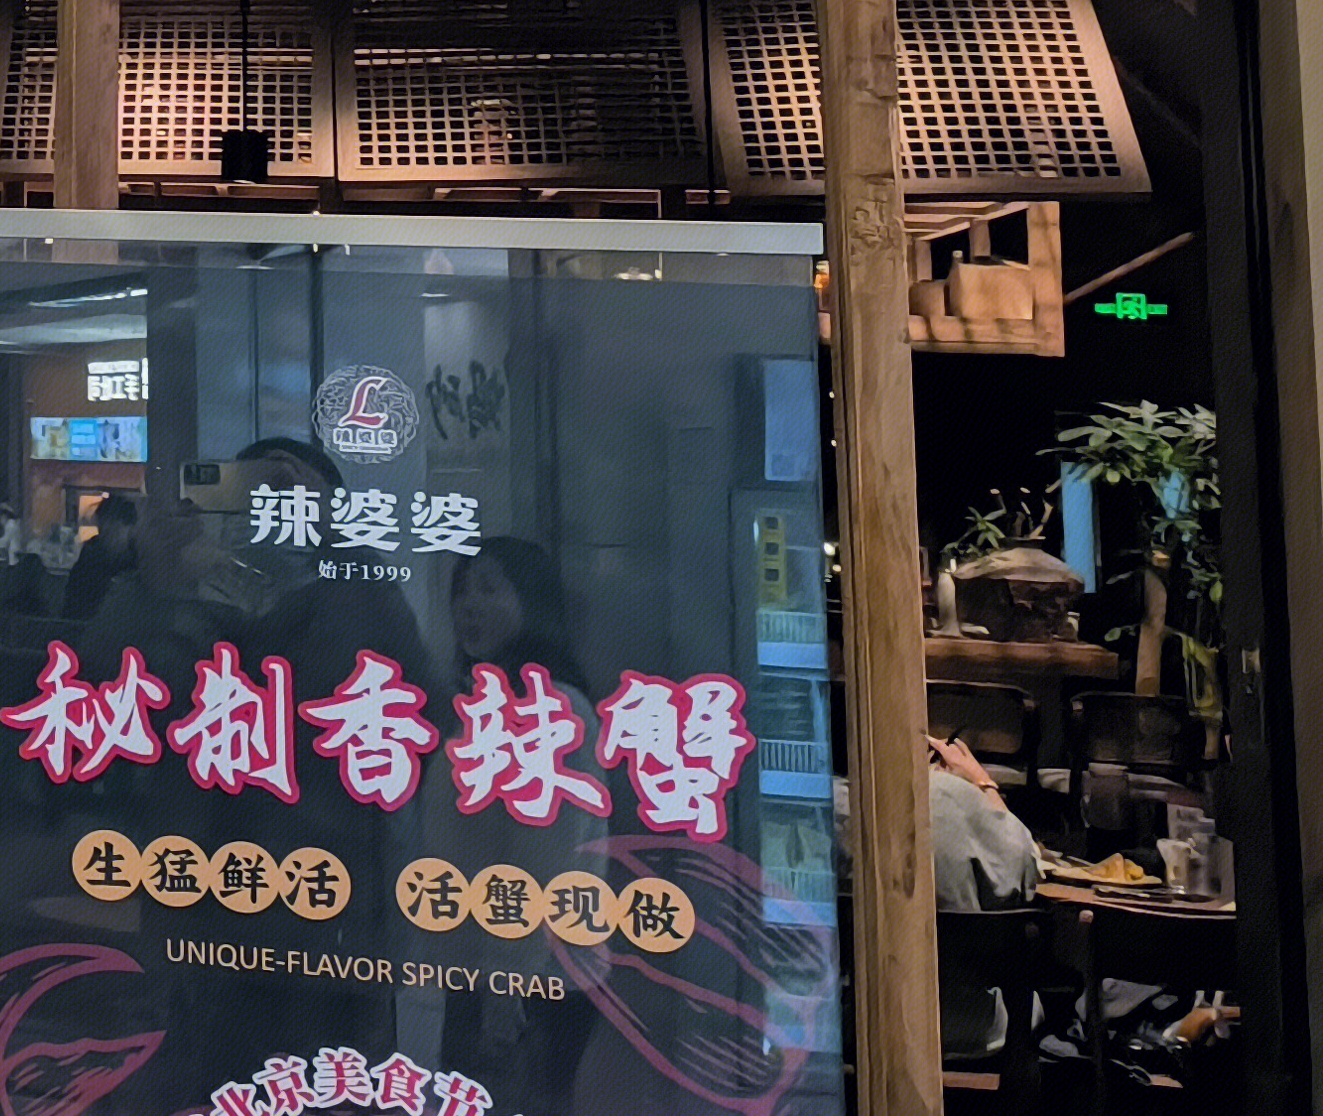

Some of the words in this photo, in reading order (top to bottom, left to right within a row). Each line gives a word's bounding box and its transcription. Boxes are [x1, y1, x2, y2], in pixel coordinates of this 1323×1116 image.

[248, 482, 483, 557] 辣婆婆
[318, 559, 412, 583] 始于1999
[0, 643, 754, 840] 秘制香辣蟹
[80, 841, 343, 910] 生猛鲜活
[405, 868, 684, 942] 活蟹现做
[165, 937, 394, 985] UNIQUE-FLAVOR
[401, 960, 480, 993] SPICY
[488, 971, 566, 1001] CRAB
